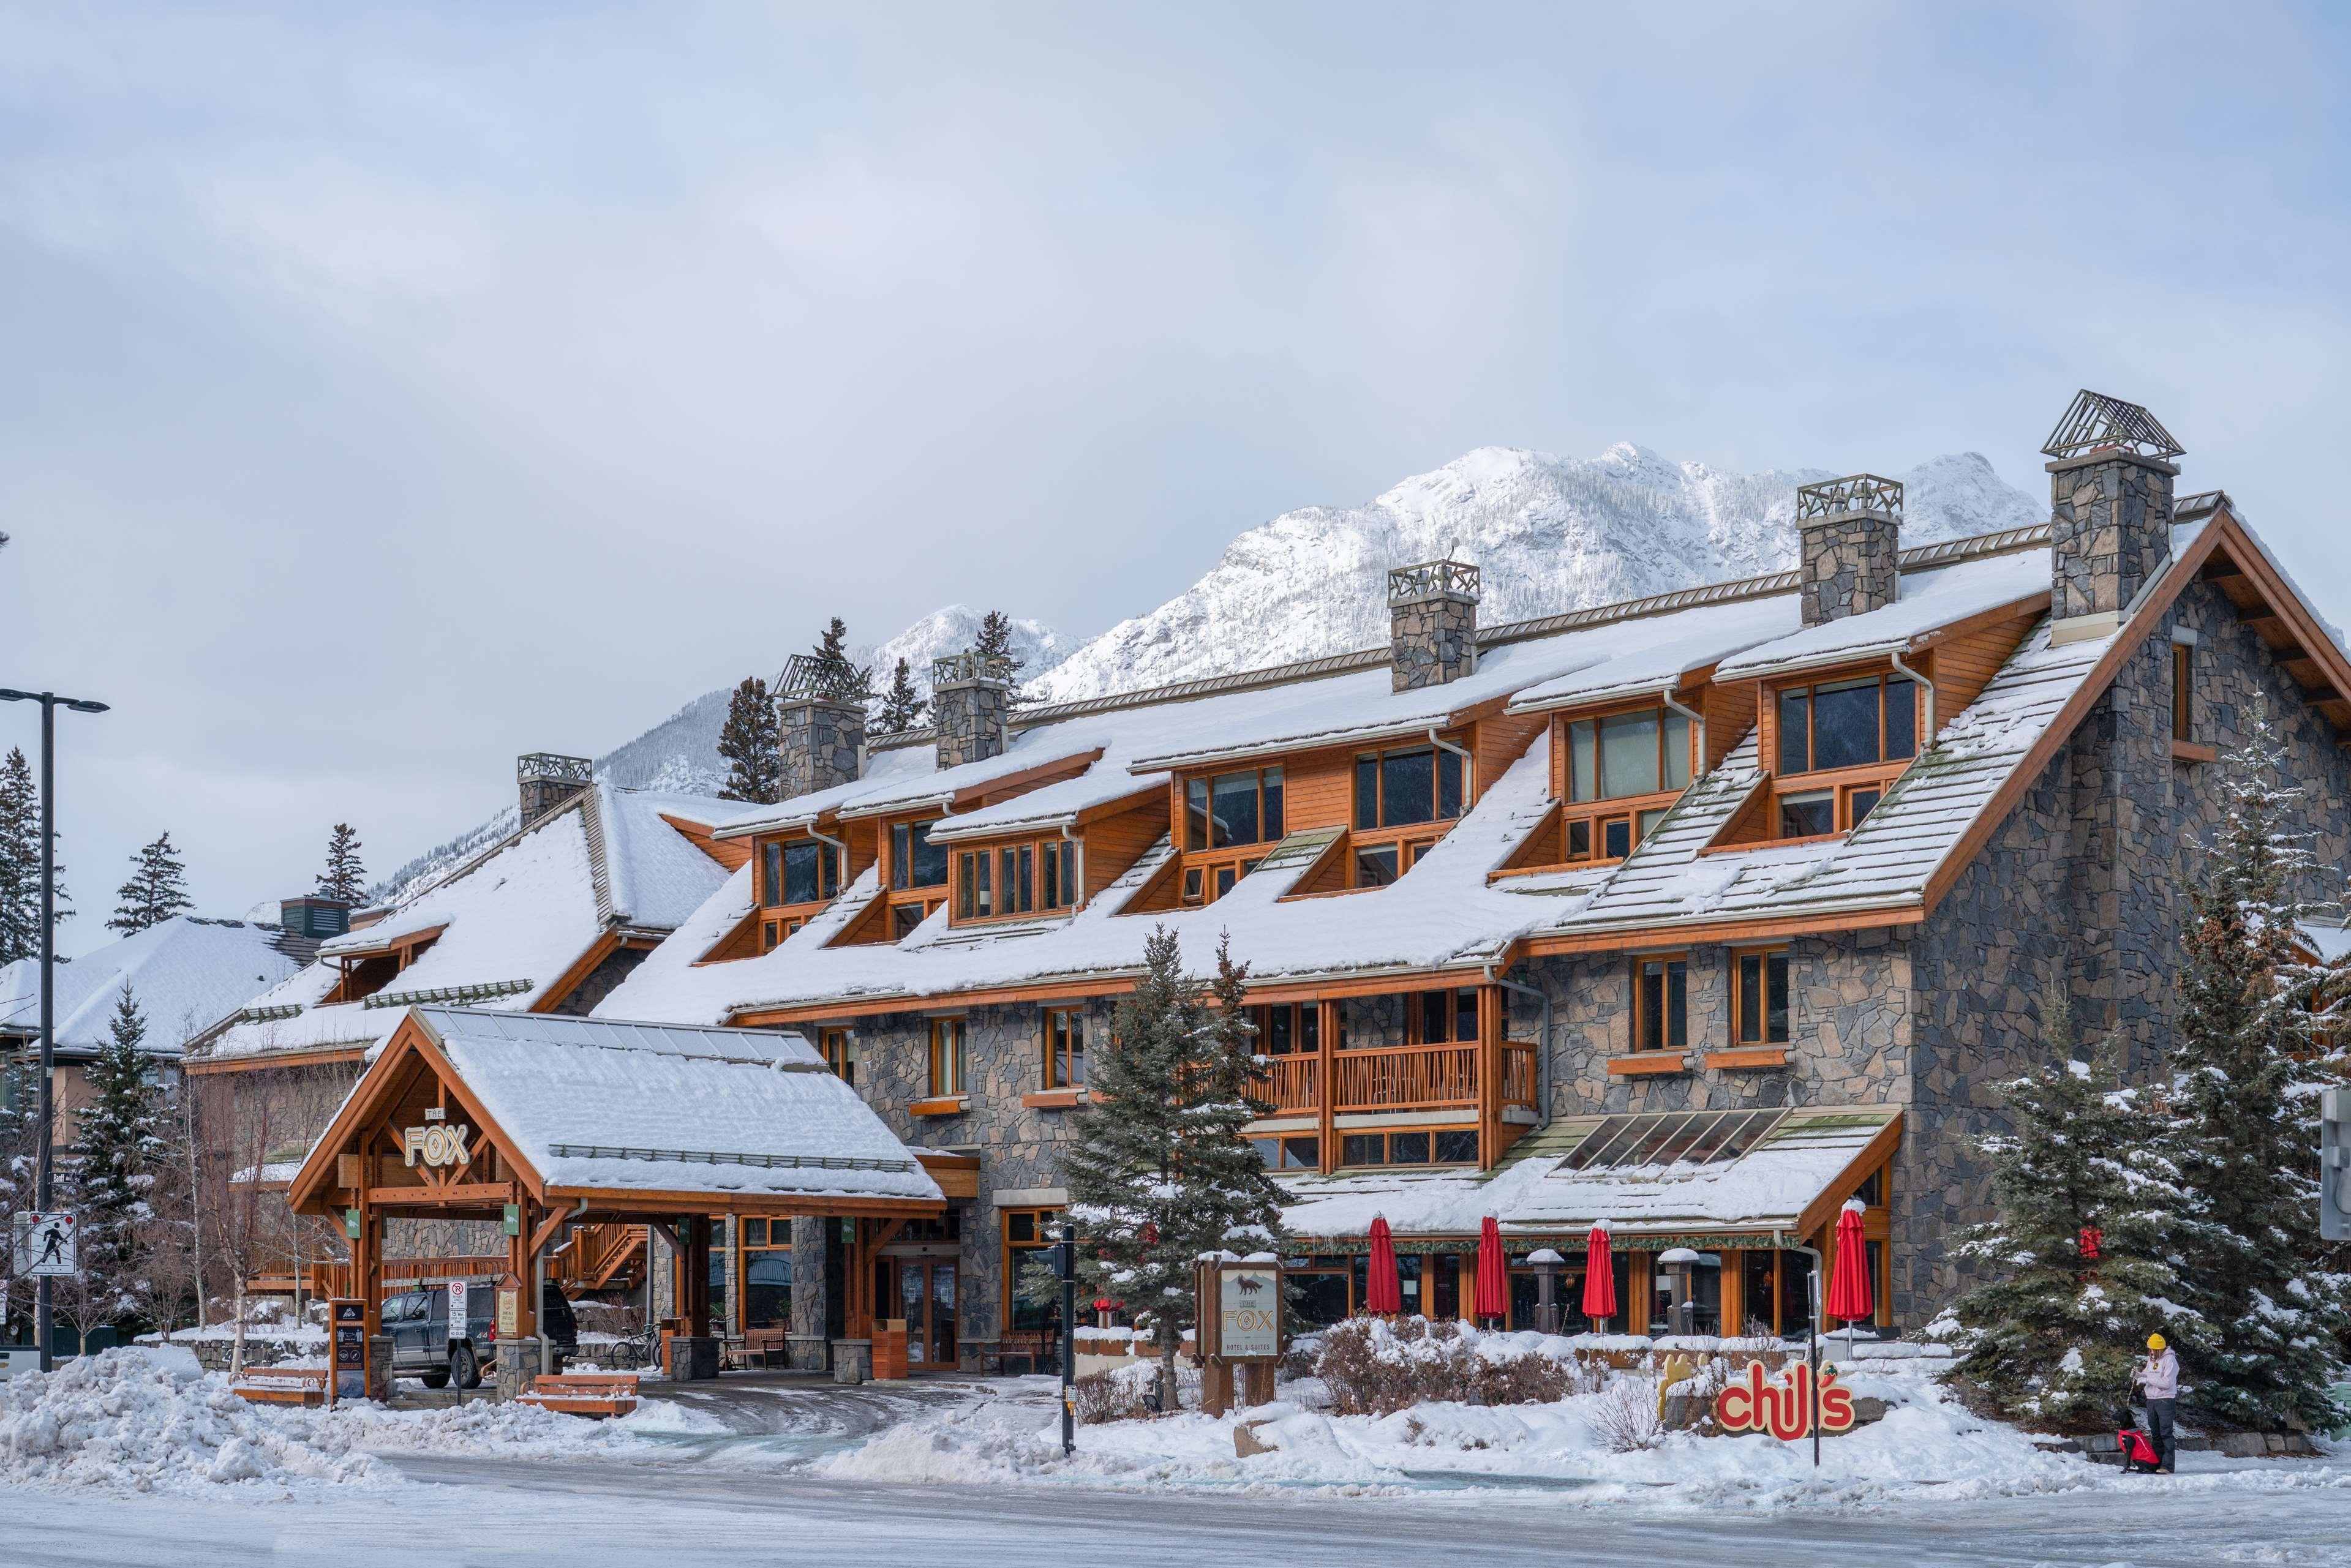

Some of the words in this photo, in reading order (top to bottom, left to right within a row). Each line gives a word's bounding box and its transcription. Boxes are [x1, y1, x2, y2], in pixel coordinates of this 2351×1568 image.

[405, 1125, 469, 1166] FOX
[53, 1174, 65, 1182] Banff
[1223, 1310, 1275, 1332] FOX
